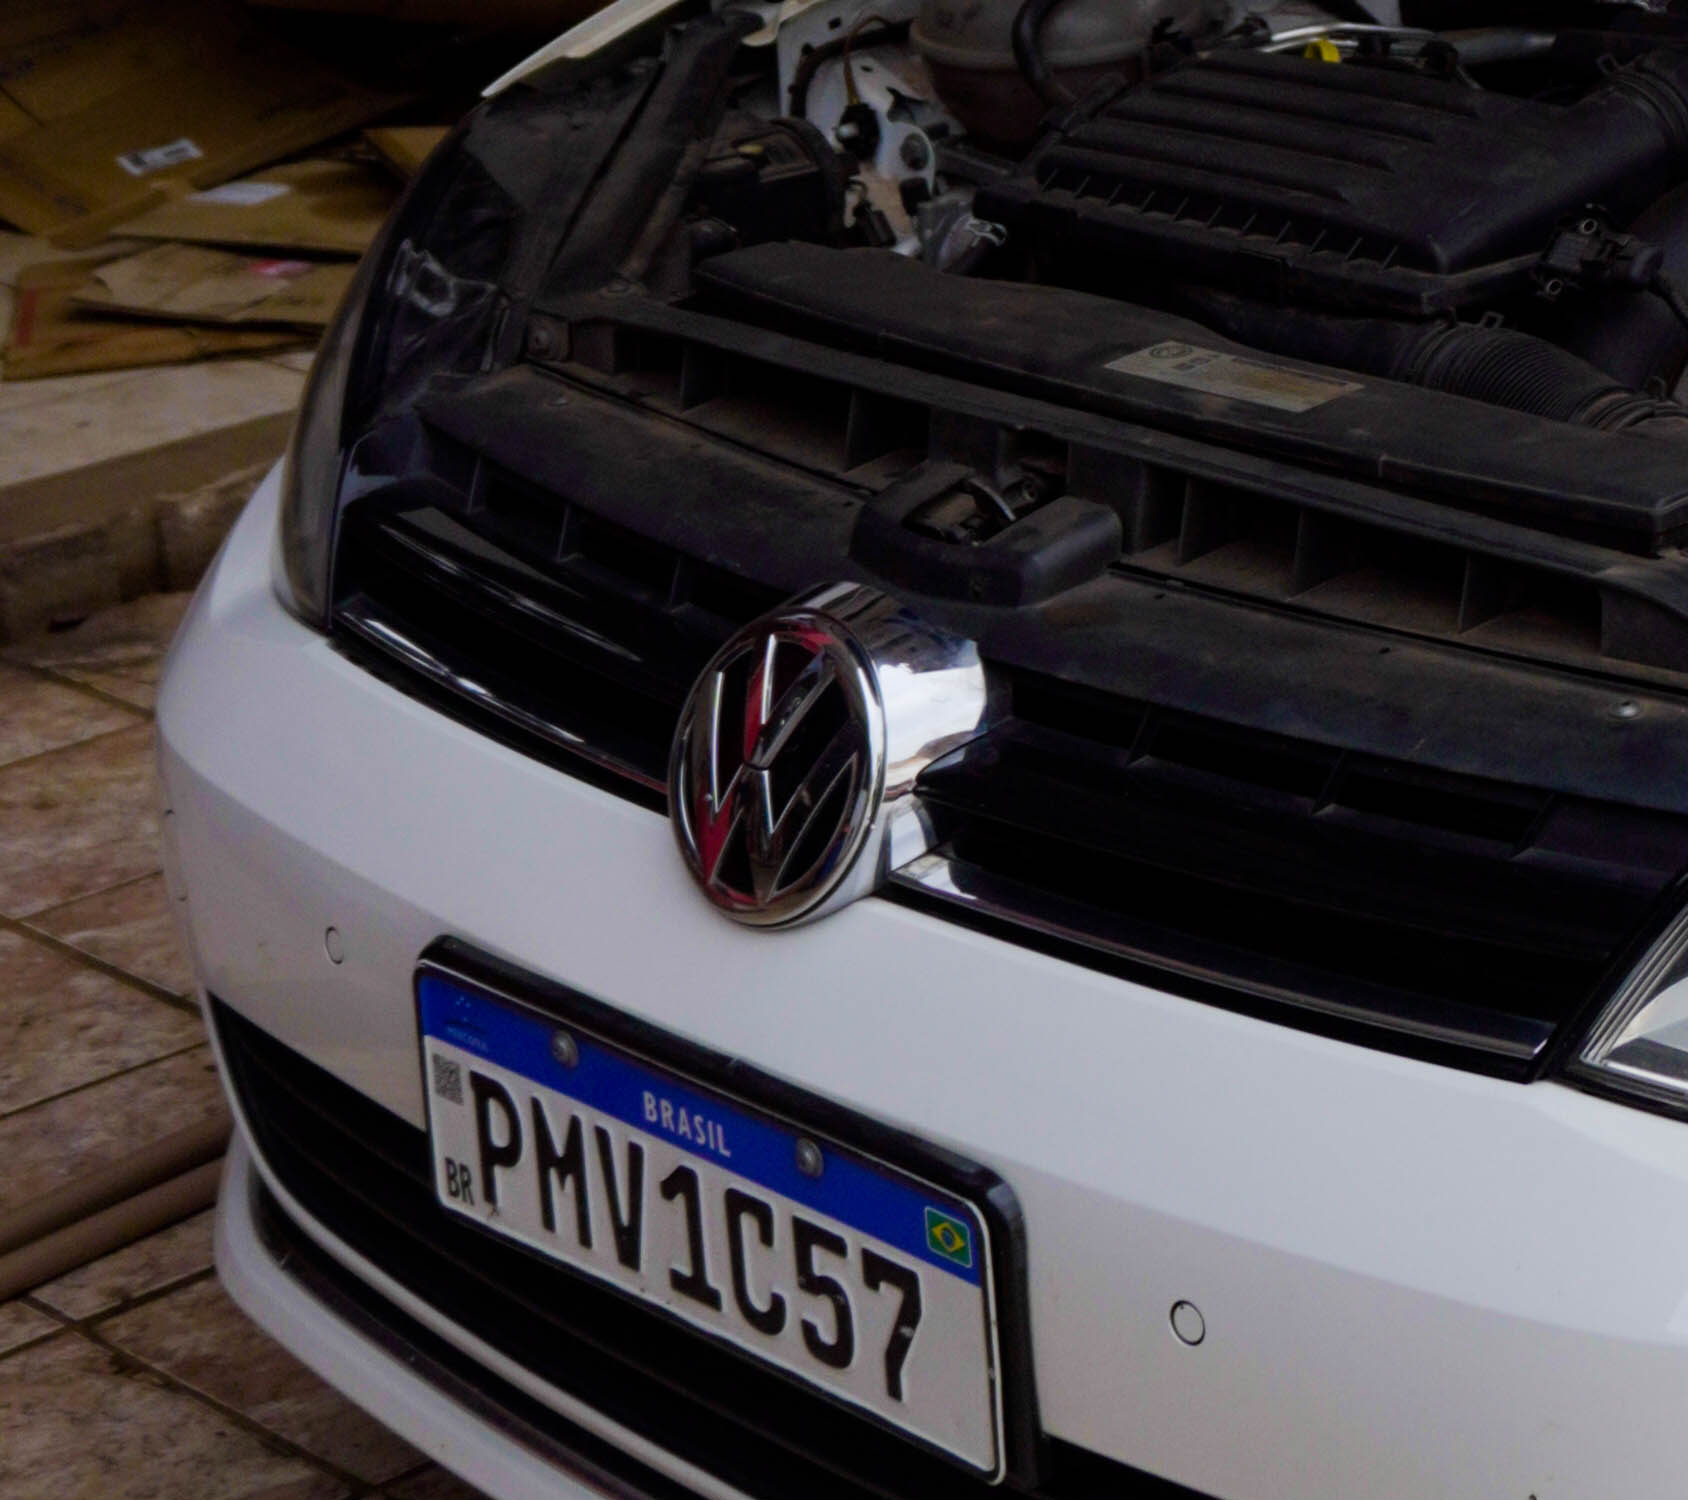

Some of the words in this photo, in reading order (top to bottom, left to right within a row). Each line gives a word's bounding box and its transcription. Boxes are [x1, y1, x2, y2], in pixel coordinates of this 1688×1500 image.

[641, 1090, 732, 1159] BRASIL
[445, 1157, 474, 1206] BR
[469, 1070, 922, 1402] PMV1C57
